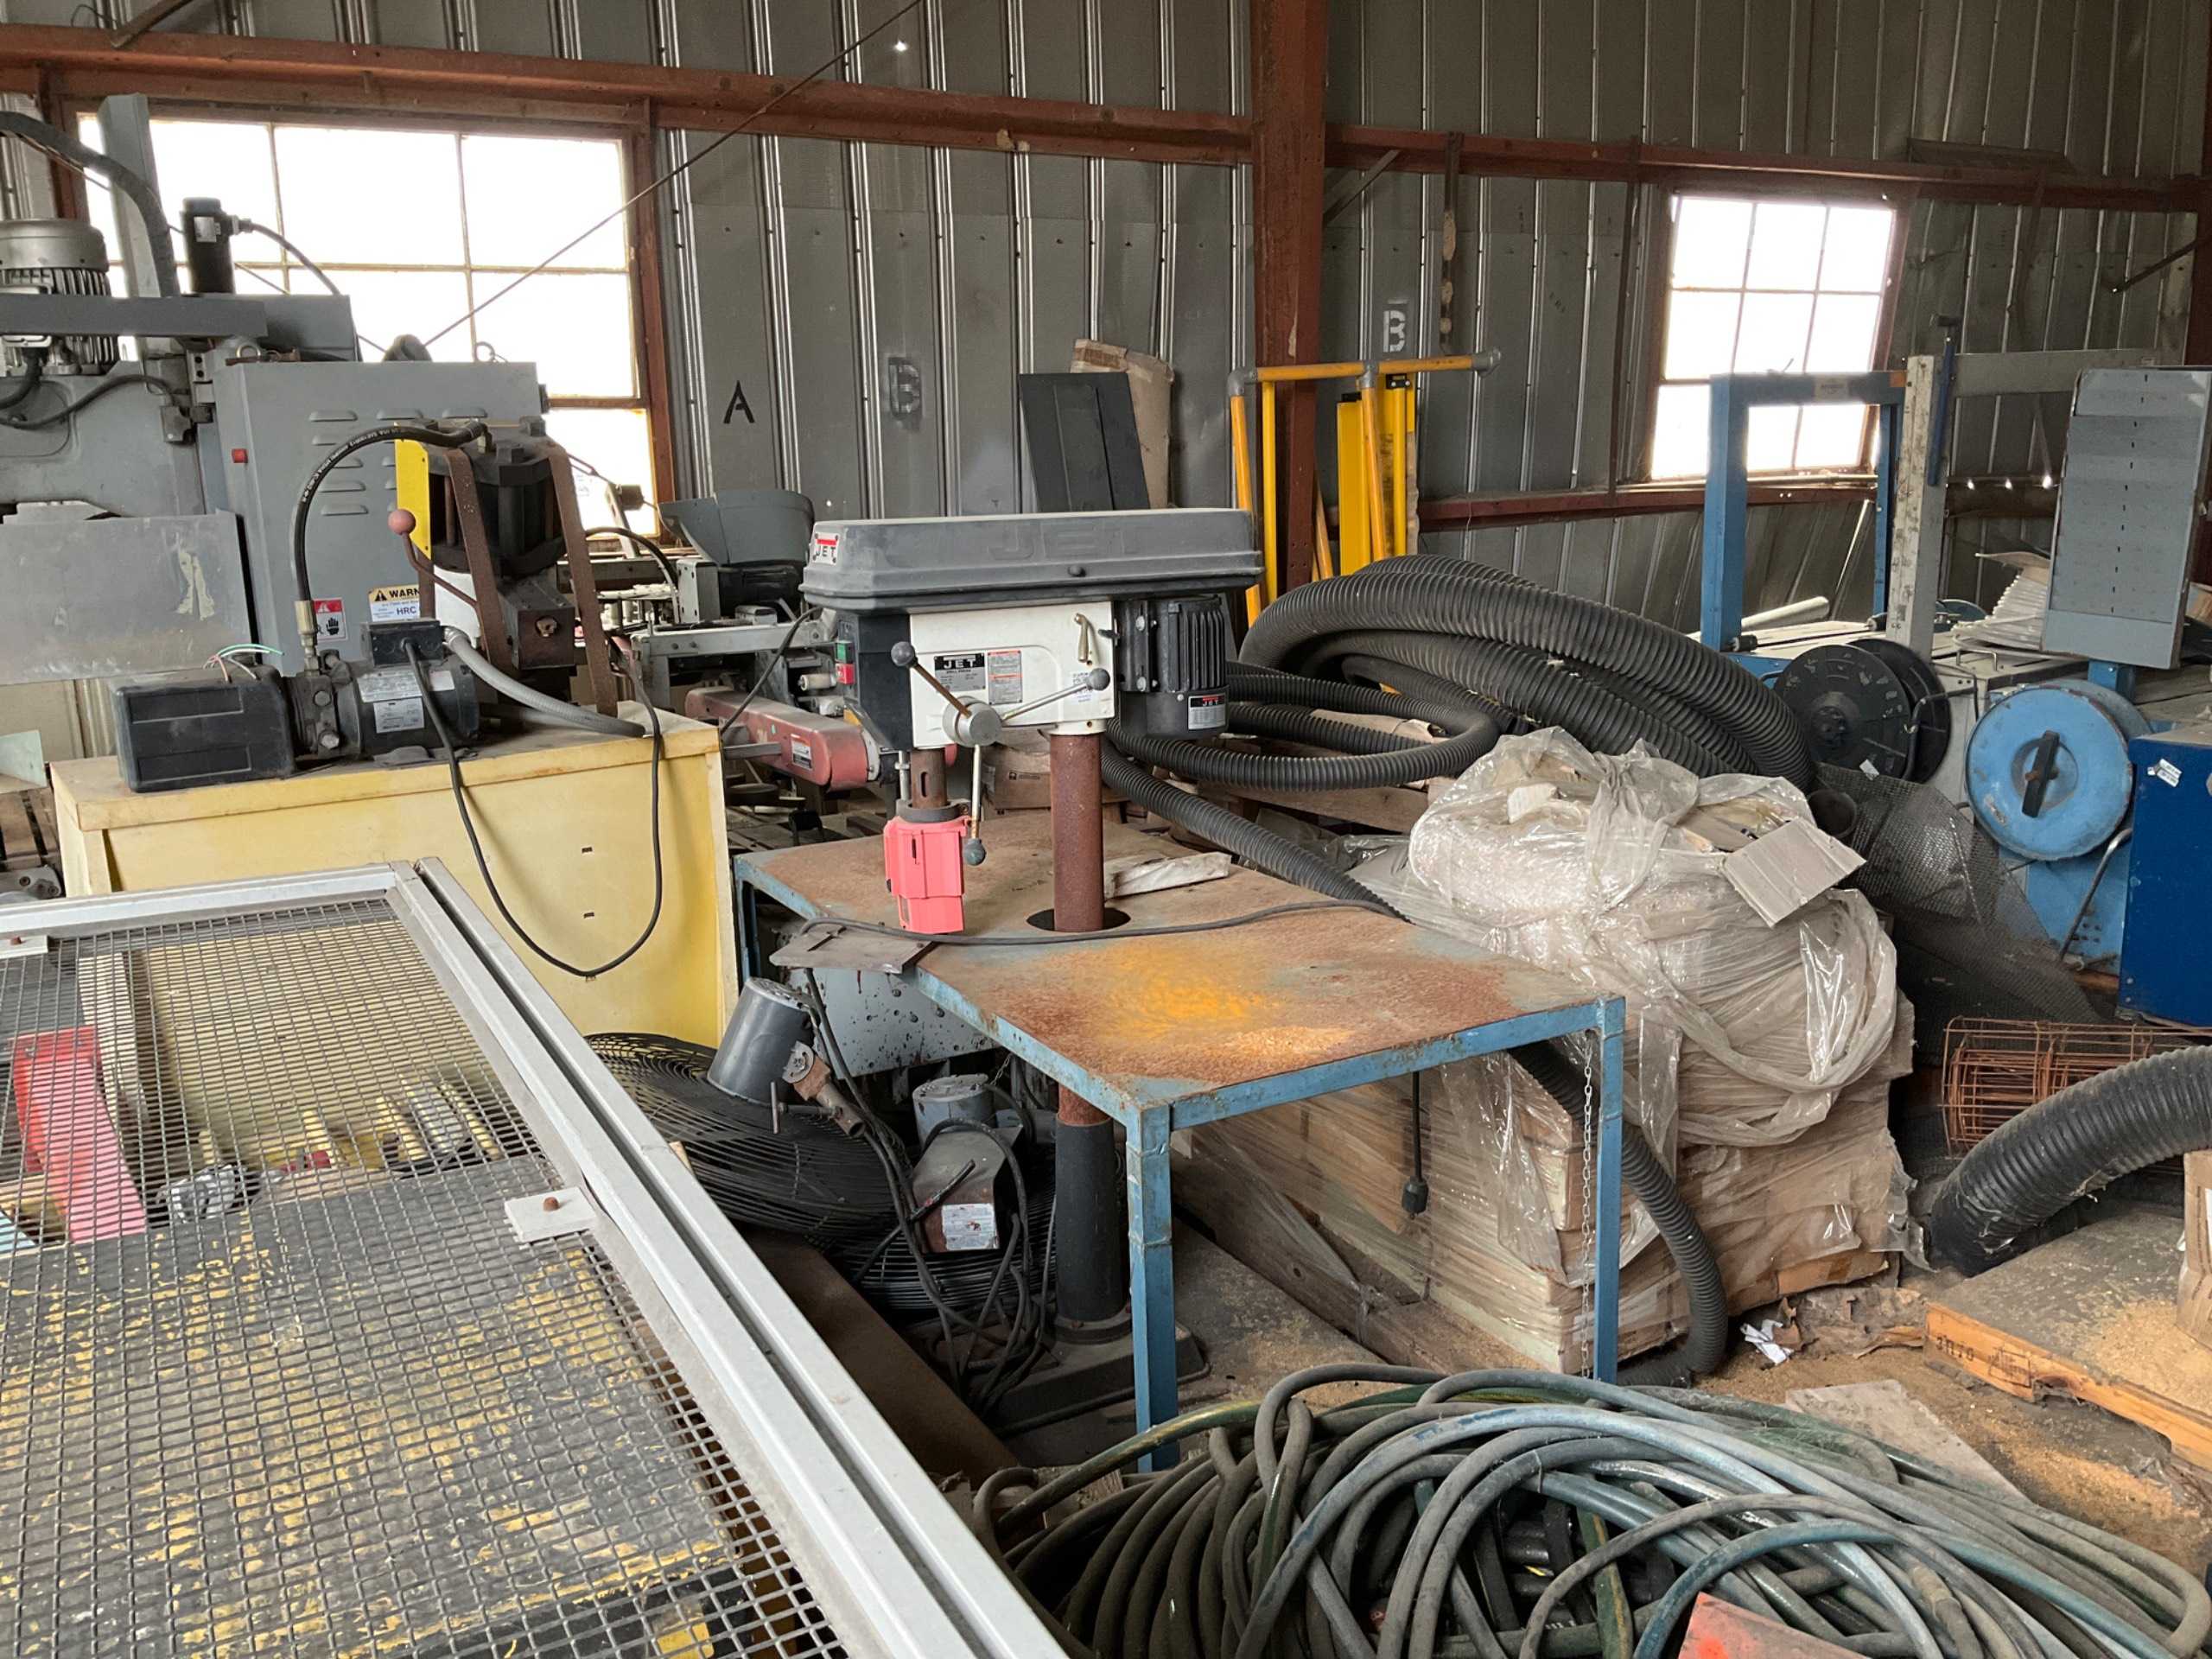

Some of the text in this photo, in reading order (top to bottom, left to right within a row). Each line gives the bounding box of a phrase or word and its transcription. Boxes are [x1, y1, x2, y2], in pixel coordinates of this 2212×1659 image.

[1382, 309, 1407, 353] B
[889, 364, 921, 415] B
[723, 380, 756, 424] A
[816, 545, 836, 557] JET
[389, 588, 421, 599] WARN
[396, 606, 417, 616] HRC
[944, 658, 976, 669] JET
